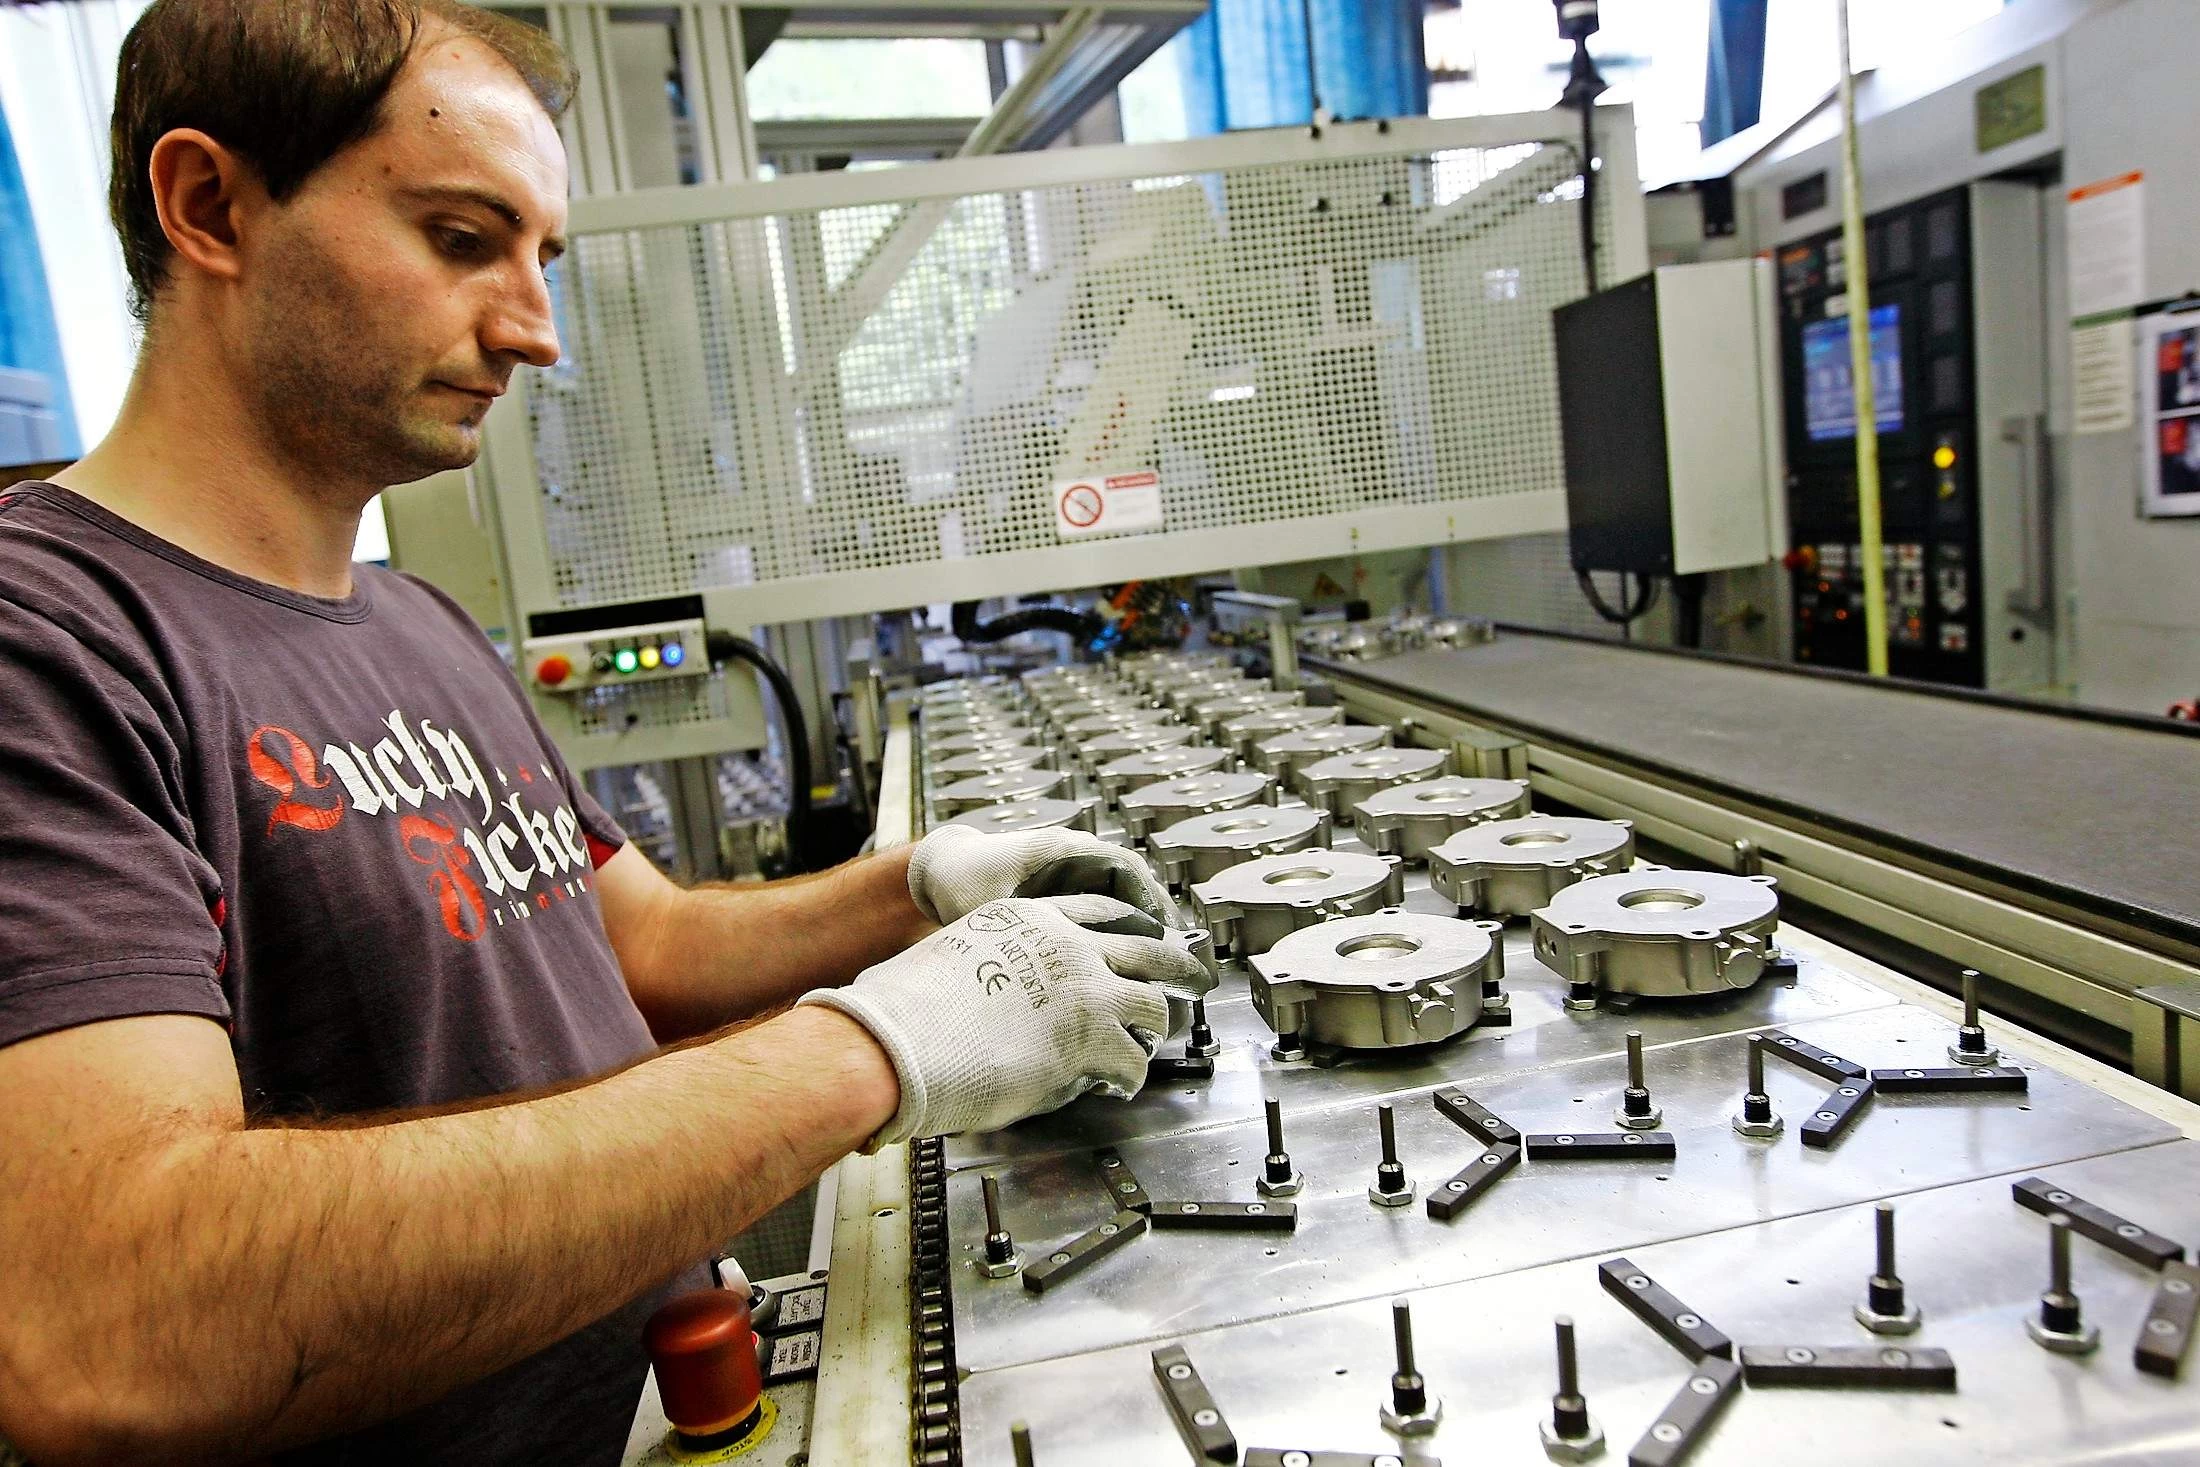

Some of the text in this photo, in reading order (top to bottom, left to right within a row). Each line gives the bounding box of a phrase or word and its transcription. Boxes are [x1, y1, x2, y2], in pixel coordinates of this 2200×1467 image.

[247, 709, 493, 838] Lucky
[995, 938, 1028, 963] ART
[976, 959, 1011, 996] CE
